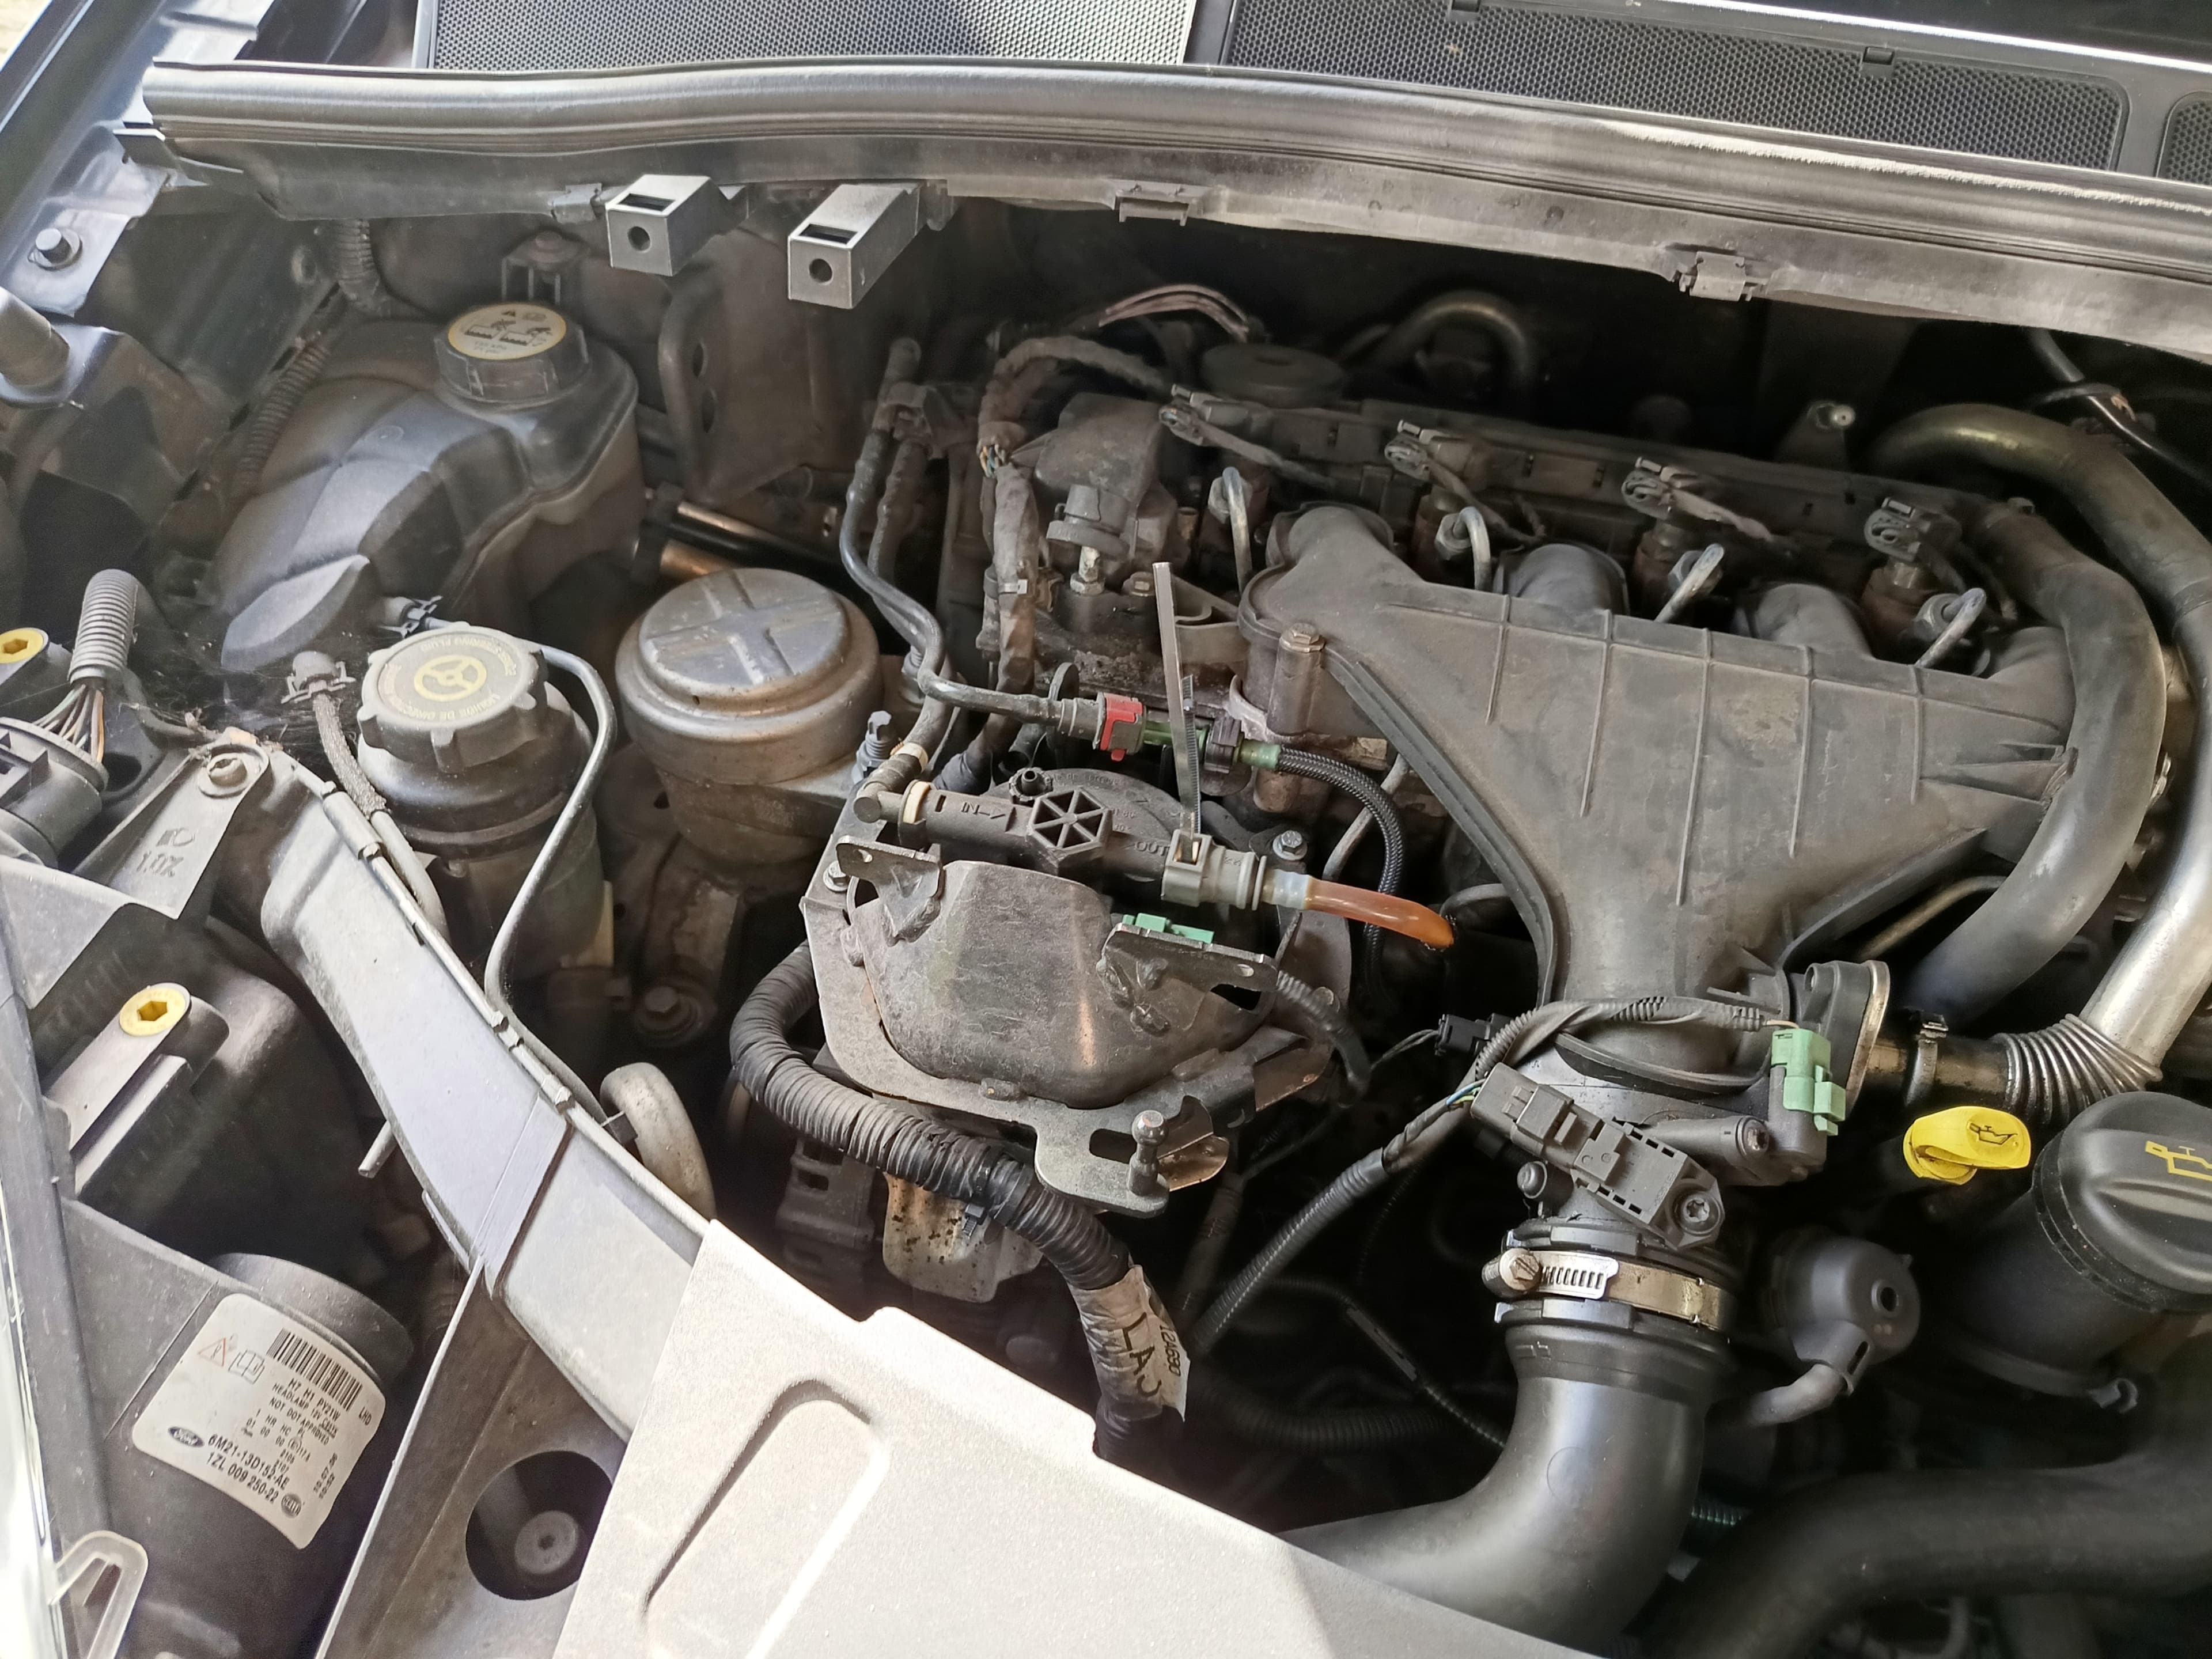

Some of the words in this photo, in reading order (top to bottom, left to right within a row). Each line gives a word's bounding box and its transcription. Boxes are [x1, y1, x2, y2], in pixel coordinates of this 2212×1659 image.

[440, 711, 456, 720] DE
[961, 801, 980, 815] IN
[1134, 840, 1171, 856] OUT
[272, 1383, 309, 1410] HEADLAMP
[288, 1377, 301, 1392] H7
[302, 1388, 315, 1401] H1
[316, 1397, 341, 1422] PY21W
[264, 1414, 278, 1427] HR
[279, 1423, 292, 1437] HC
[269, 1397, 286, 1412] NOT
[286, 1407, 302, 1422] DOT
[300, 1418, 330, 1445] APPROVED
[358, 1406, 373, 1426] LHD
[260, 1426, 271, 1438] 00
[275, 1435, 286, 1447] 00
[206, 1452, 226, 1471] 1ZL
[227, 1463, 249, 1483] 009
[247, 1475, 279, 1505] 250-22
